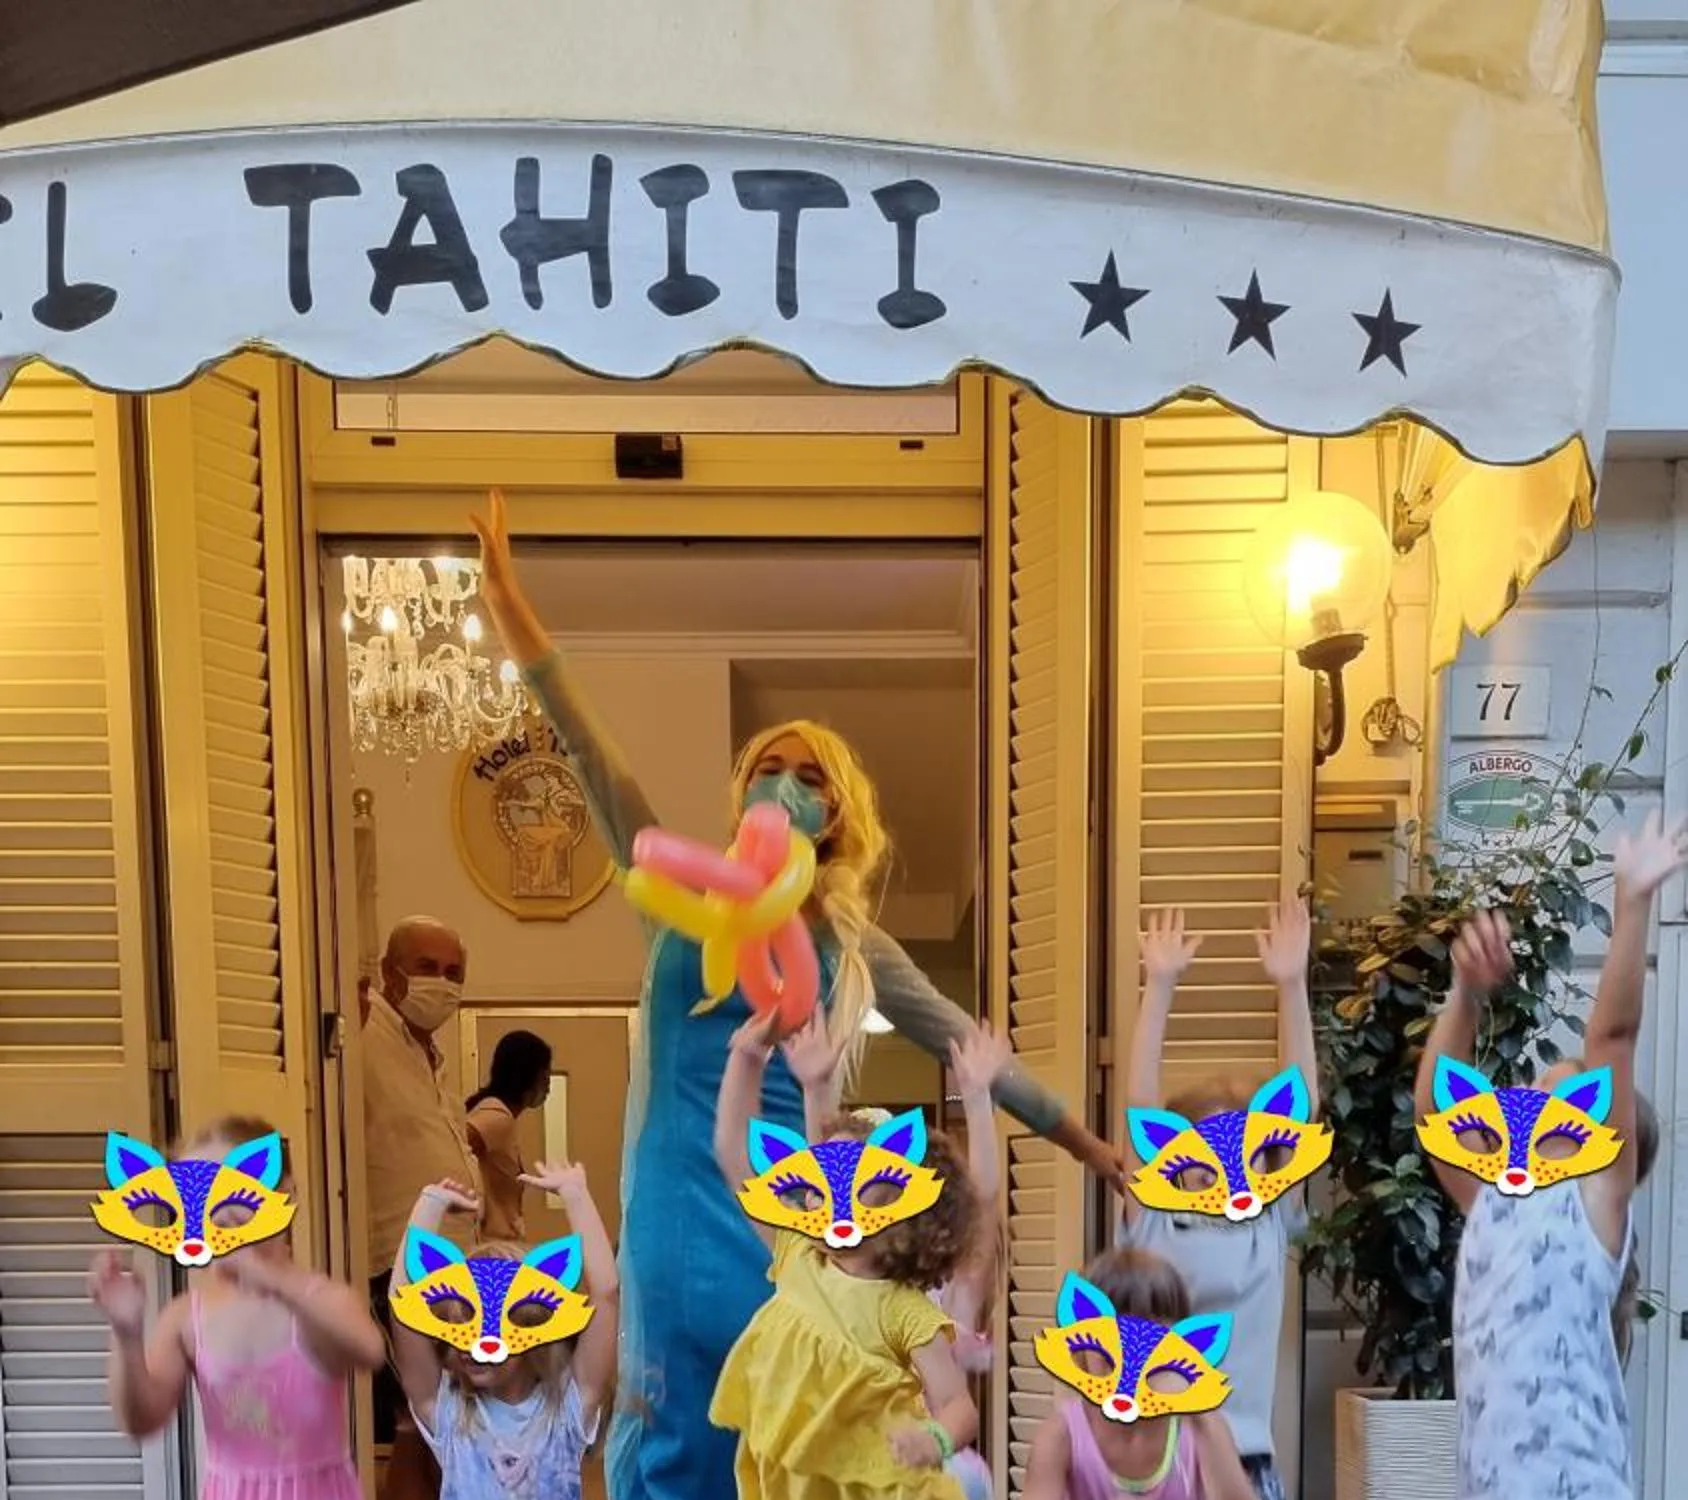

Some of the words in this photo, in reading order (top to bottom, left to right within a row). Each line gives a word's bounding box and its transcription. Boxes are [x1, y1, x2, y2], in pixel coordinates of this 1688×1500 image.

[0, 180, 118, 333] L
[243, 153, 947, 330] TAHITI
[1475, 682, 1522, 721] 77
[1468, 757, 1533, 774] ALBERGO
